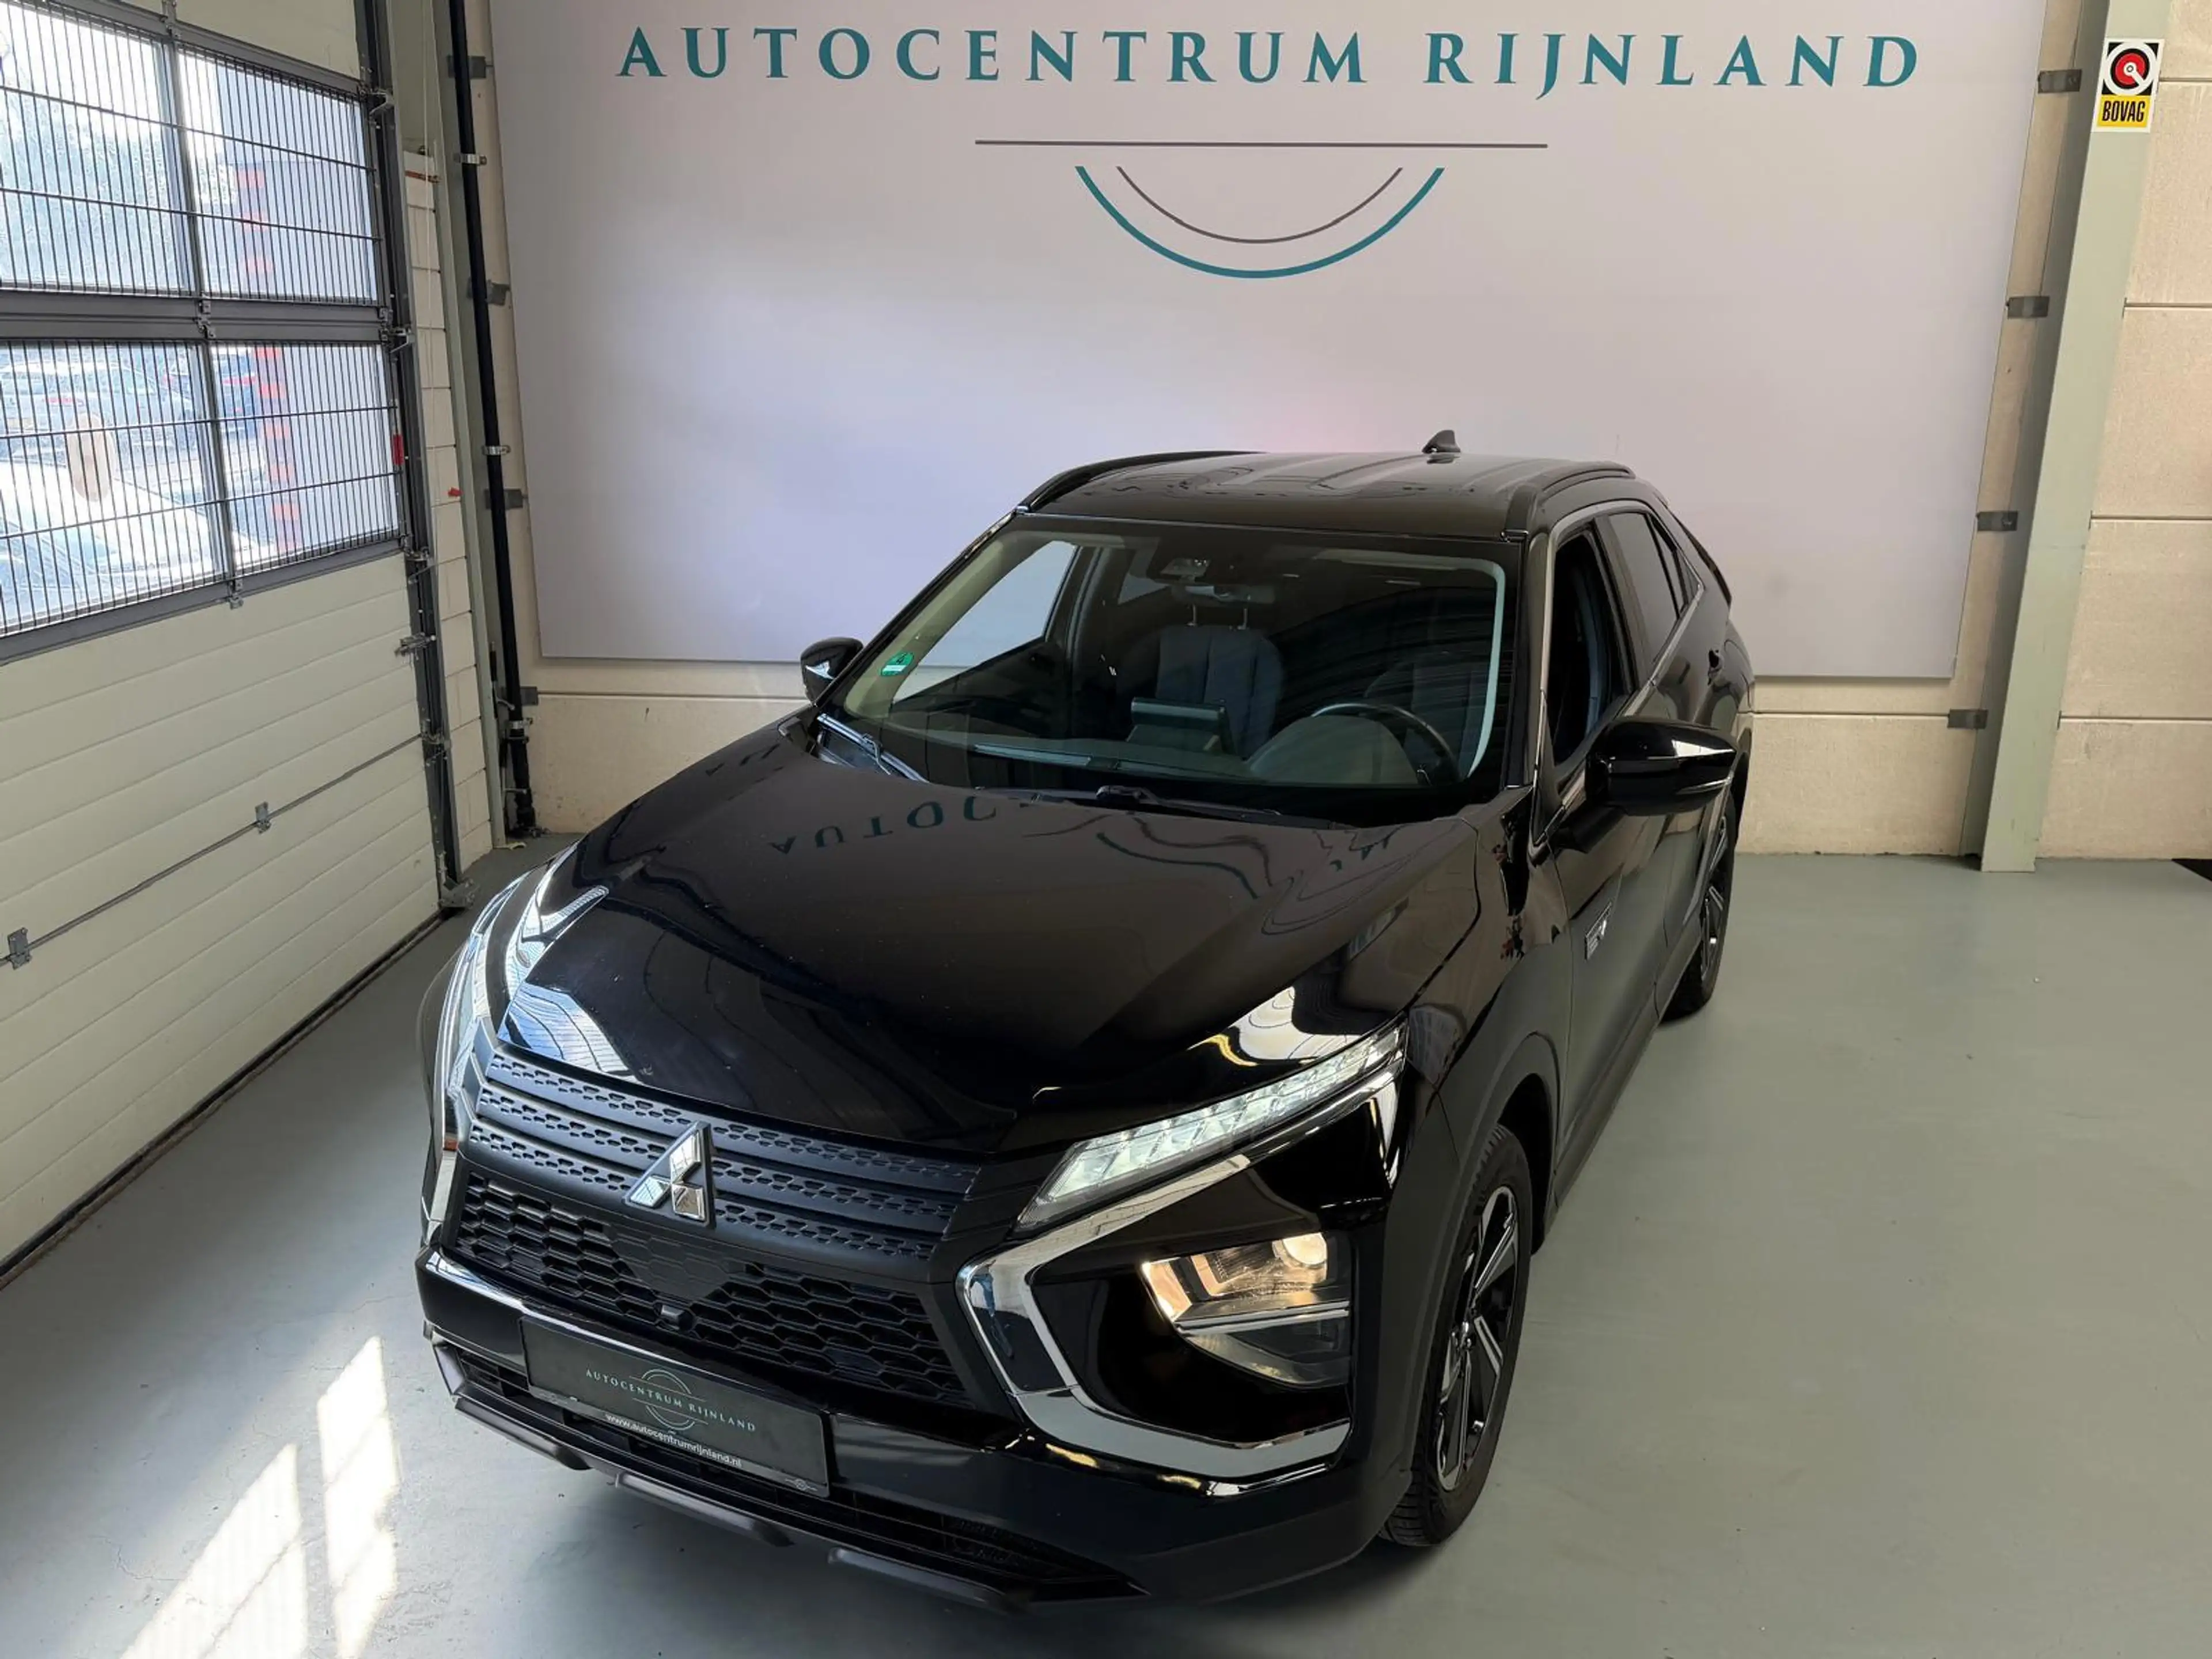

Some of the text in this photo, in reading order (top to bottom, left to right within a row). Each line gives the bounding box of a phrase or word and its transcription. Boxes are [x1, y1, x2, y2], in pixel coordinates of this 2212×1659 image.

[615, 26, 1918, 100] AUTOCENTRUM RIJNLAND
[2102, 100, 2146, 123] BOVAG
[585, 1368, 756, 1433] AUTOCENTRUM RIJNLAND
[605, 1414, 743, 1468] www.autocentrumrijnland.nl
